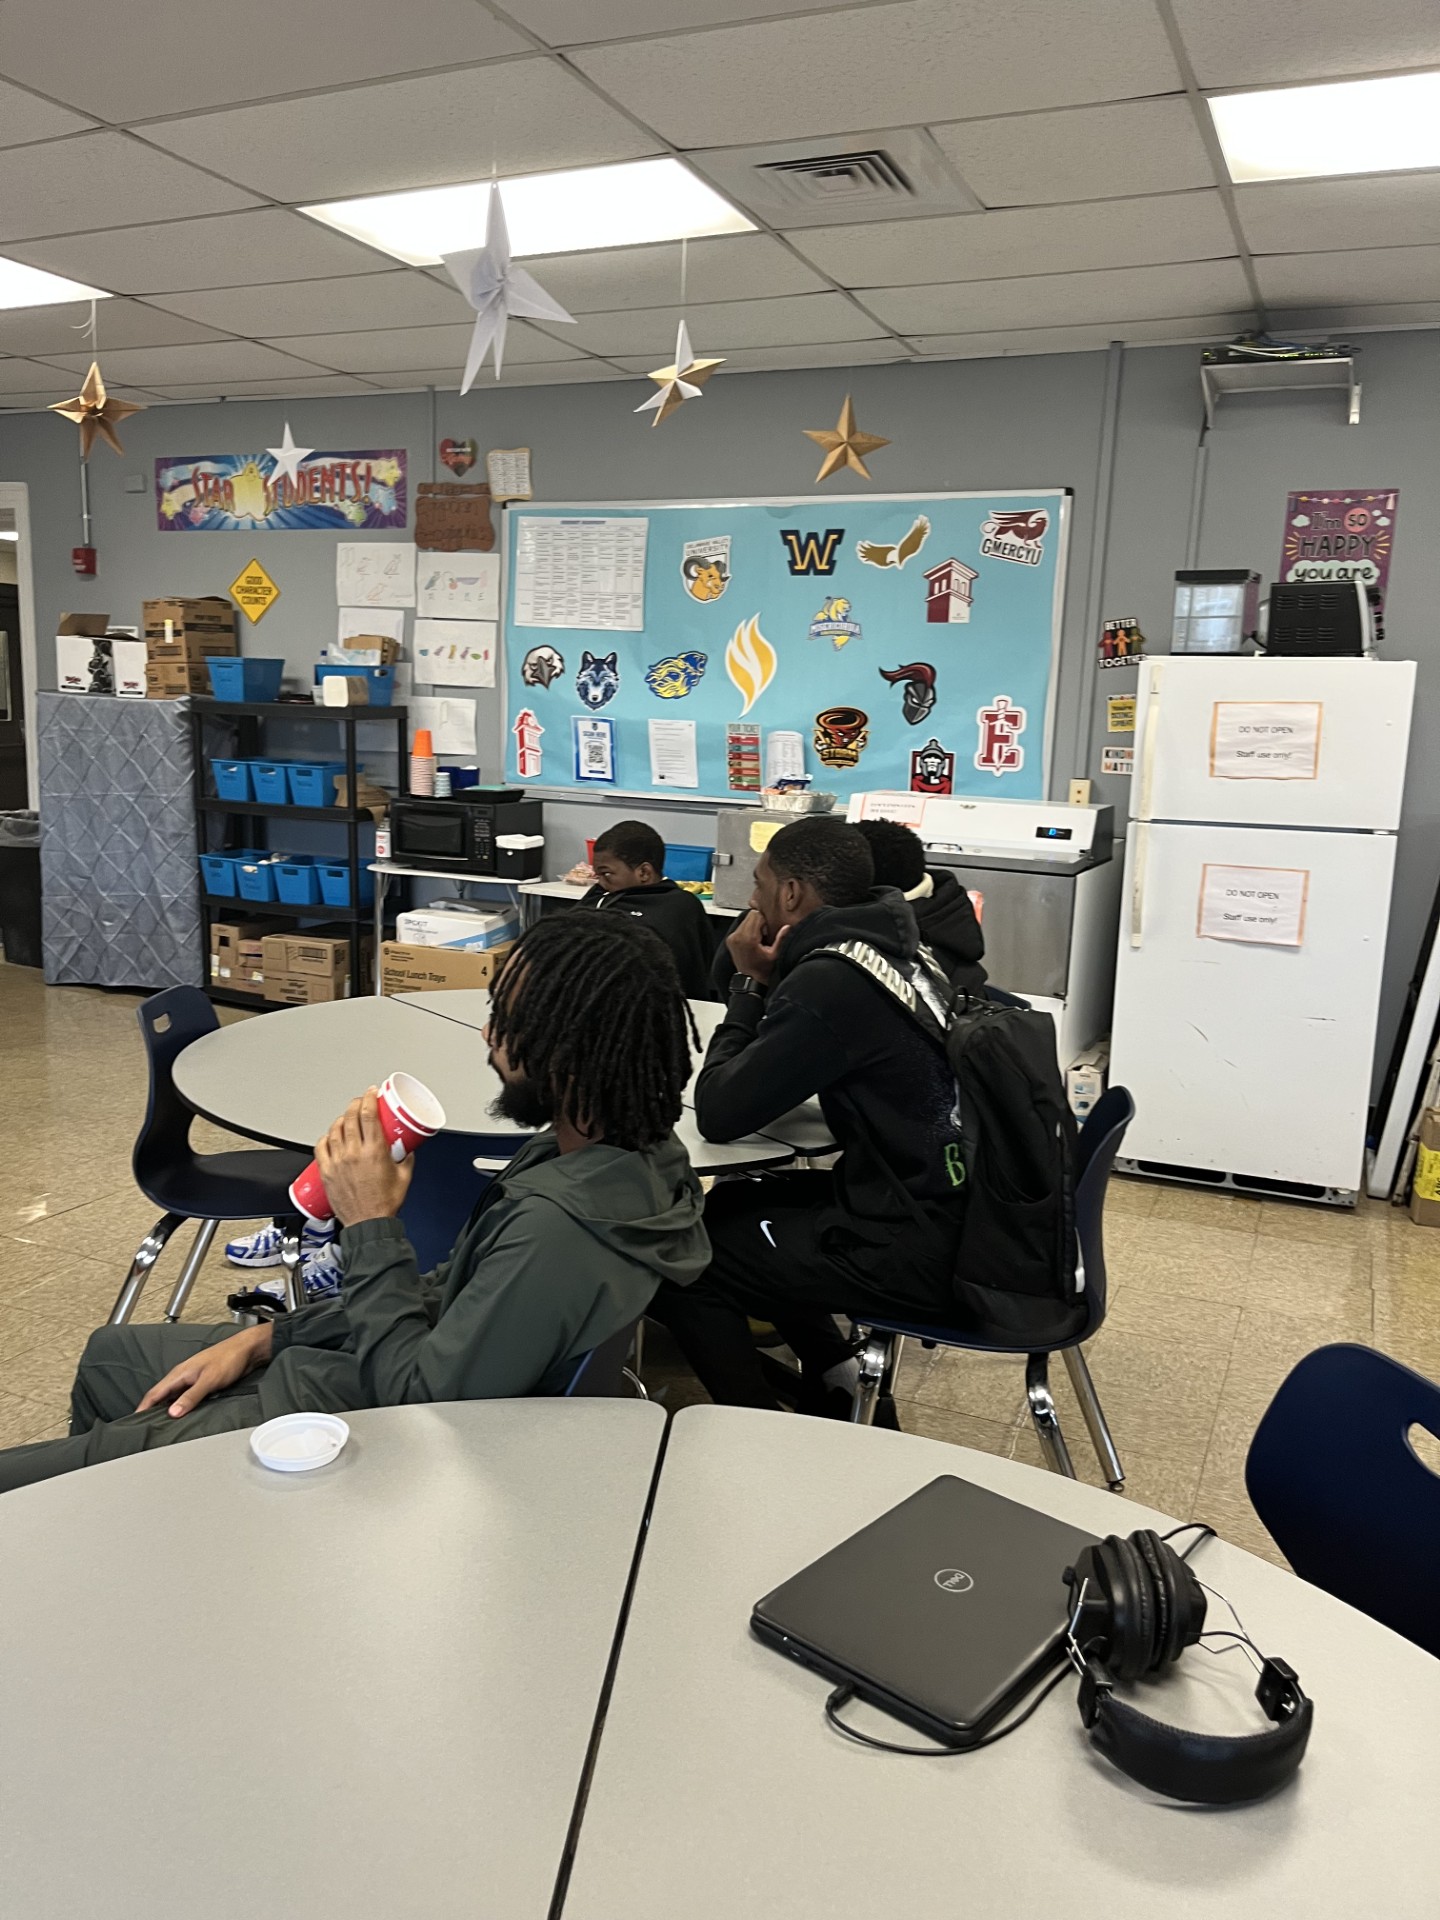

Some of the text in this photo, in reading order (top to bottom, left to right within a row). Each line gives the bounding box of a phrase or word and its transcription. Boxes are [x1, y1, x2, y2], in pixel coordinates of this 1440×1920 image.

[191, 466, 236, 512] STAR
[779, 529, 846, 576] W
[981, 538, 1043, 565] GMERCYU
[1300, 534, 1376, 558] HAPPY
[1294, 566, 1375, 582] you are
[235, 585, 272, 595] CHARACTER
[1104, 618, 1138, 630] BETTER
[1238, 725, 1251, 733] DO
[1271, 726, 1293, 734] OPEN
[1236, 750, 1255, 758] Staff
[1226, 889, 1238, 897] DO
[1257, 891, 1279, 899] OPEN
[1223, 912, 1242, 920] Staff
[384, 967, 406, 978] School
[406, 970, 428, 980] Lunch
[428, 972, 447, 984] Trays
[481, 966, 488, 977] 4
[942, 1572, 965, 1588] DELL
